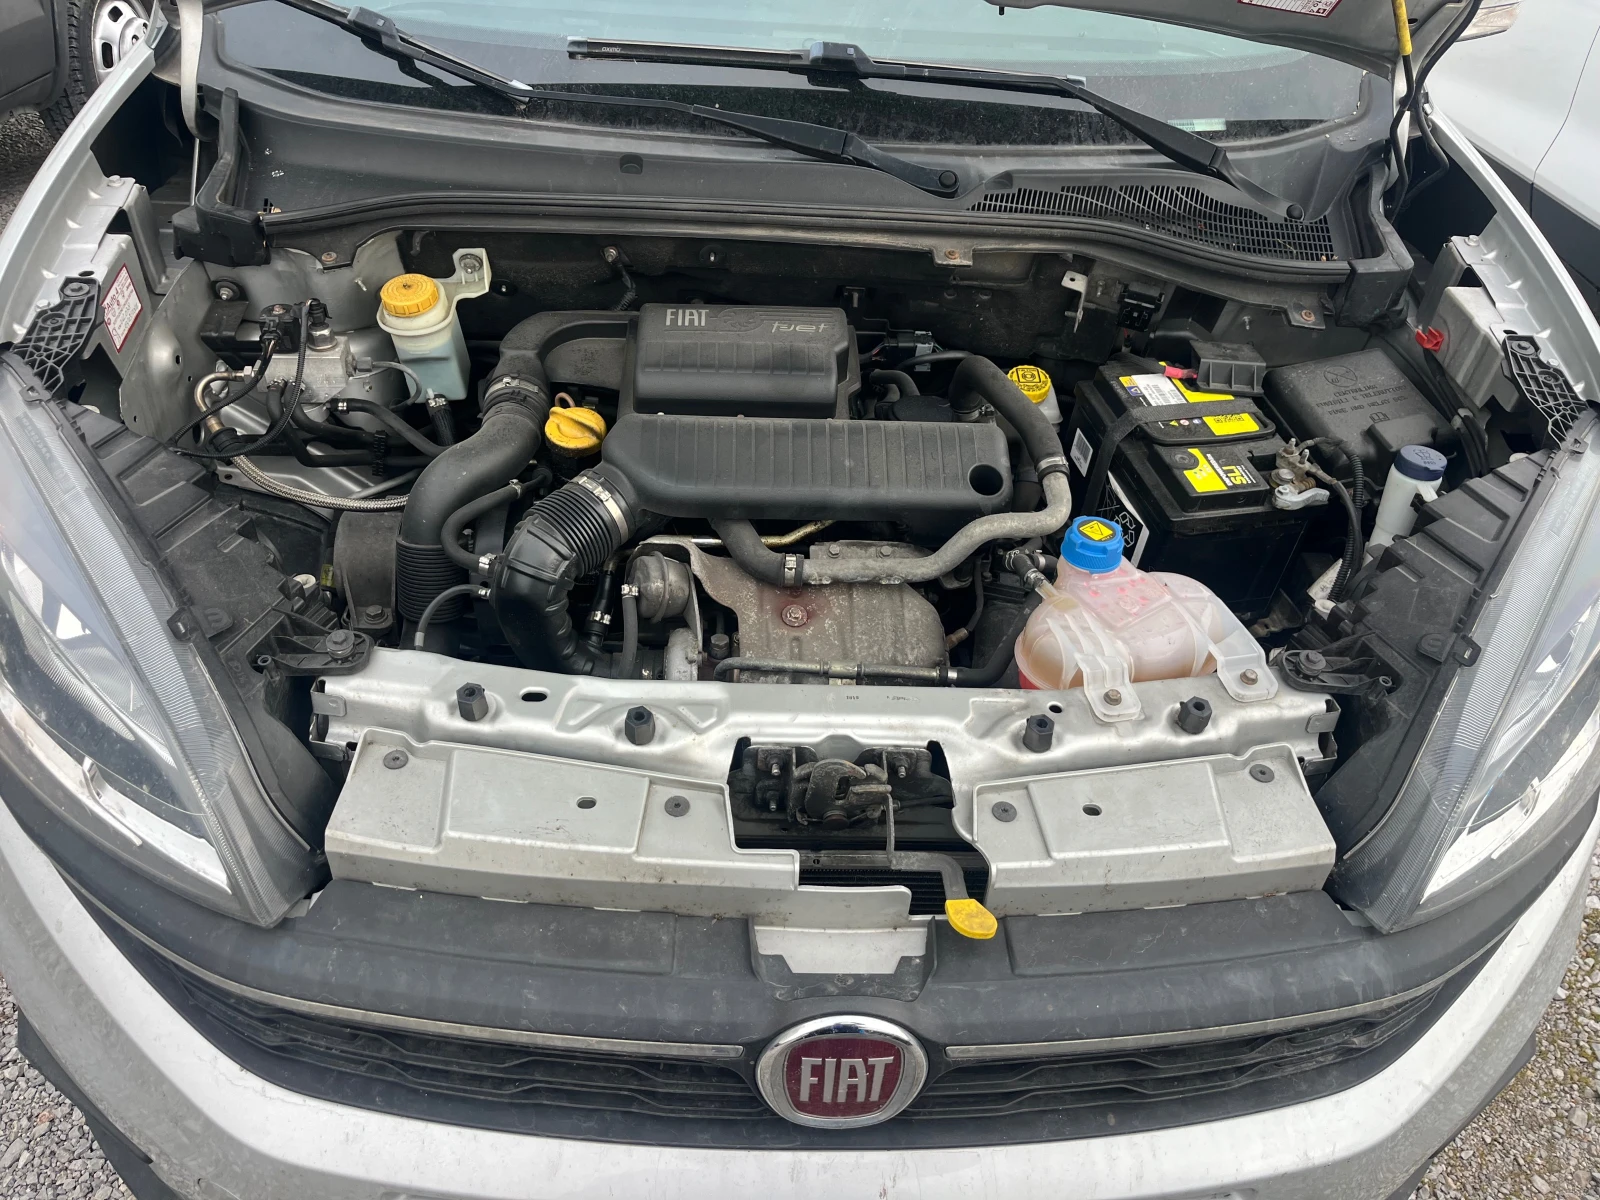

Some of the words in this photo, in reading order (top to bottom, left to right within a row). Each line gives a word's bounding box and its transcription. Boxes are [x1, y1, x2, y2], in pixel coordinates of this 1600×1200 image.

[665, 308, 710, 327] FIAT
[1328, 407, 1349, 416] FUSE
[1350, 404, 1365, 412] AND
[1367, 398, 1391, 408] RELAY
[799, 1056, 894, 1104] FIAT
